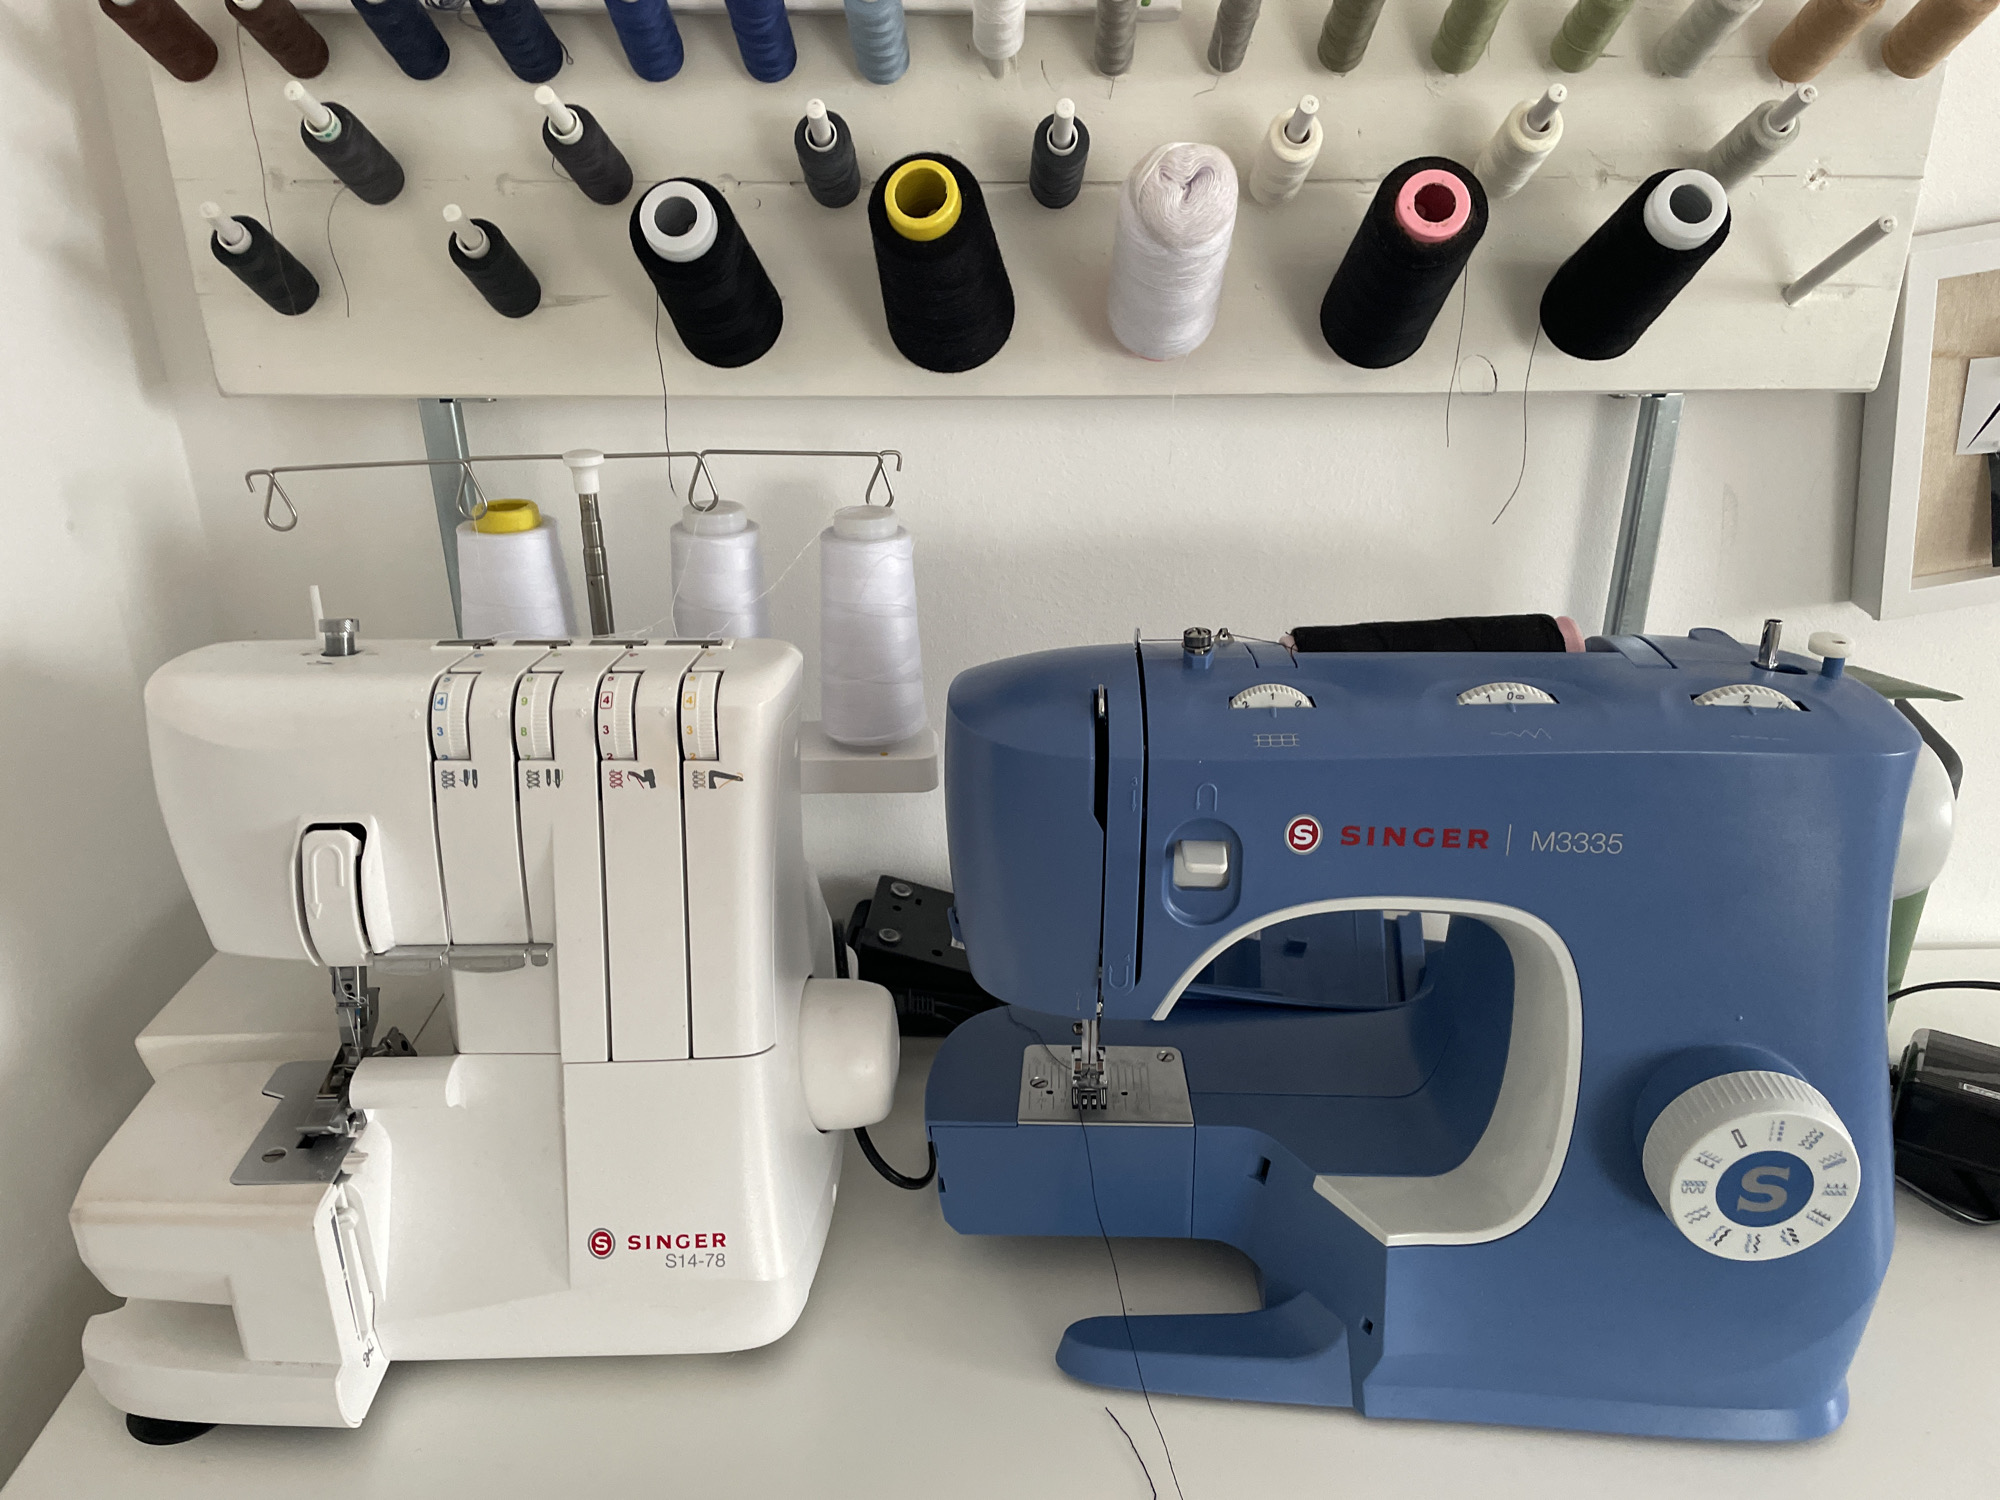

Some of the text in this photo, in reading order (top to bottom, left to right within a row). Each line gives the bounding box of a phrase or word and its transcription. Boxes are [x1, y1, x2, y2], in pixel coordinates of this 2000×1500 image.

[603, 695, 610, 705] 4
[686, 695, 693, 705] 4
[1270, 692, 1275, 700] 1
[1486, 694, 1491, 702] 1
[1743, 694, 1751, 704] 2
[437, 697, 444, 706] 4
[521, 697, 528, 706] 9
[1294, 700, 1302, 708] 0
[437, 726, 444, 736] 3
[520, 727, 528, 736] 8
[603, 725, 610, 735] 3
[686, 725, 693, 735] 3
[1340, 825, 1490, 850] SINGER
[1530, 830, 1624, 855] M3335
[1736, 1165, 1791, 1213] S
[627, 1232, 727, 1251] SINGER
[665, 1253, 726, 1269] S14-78
